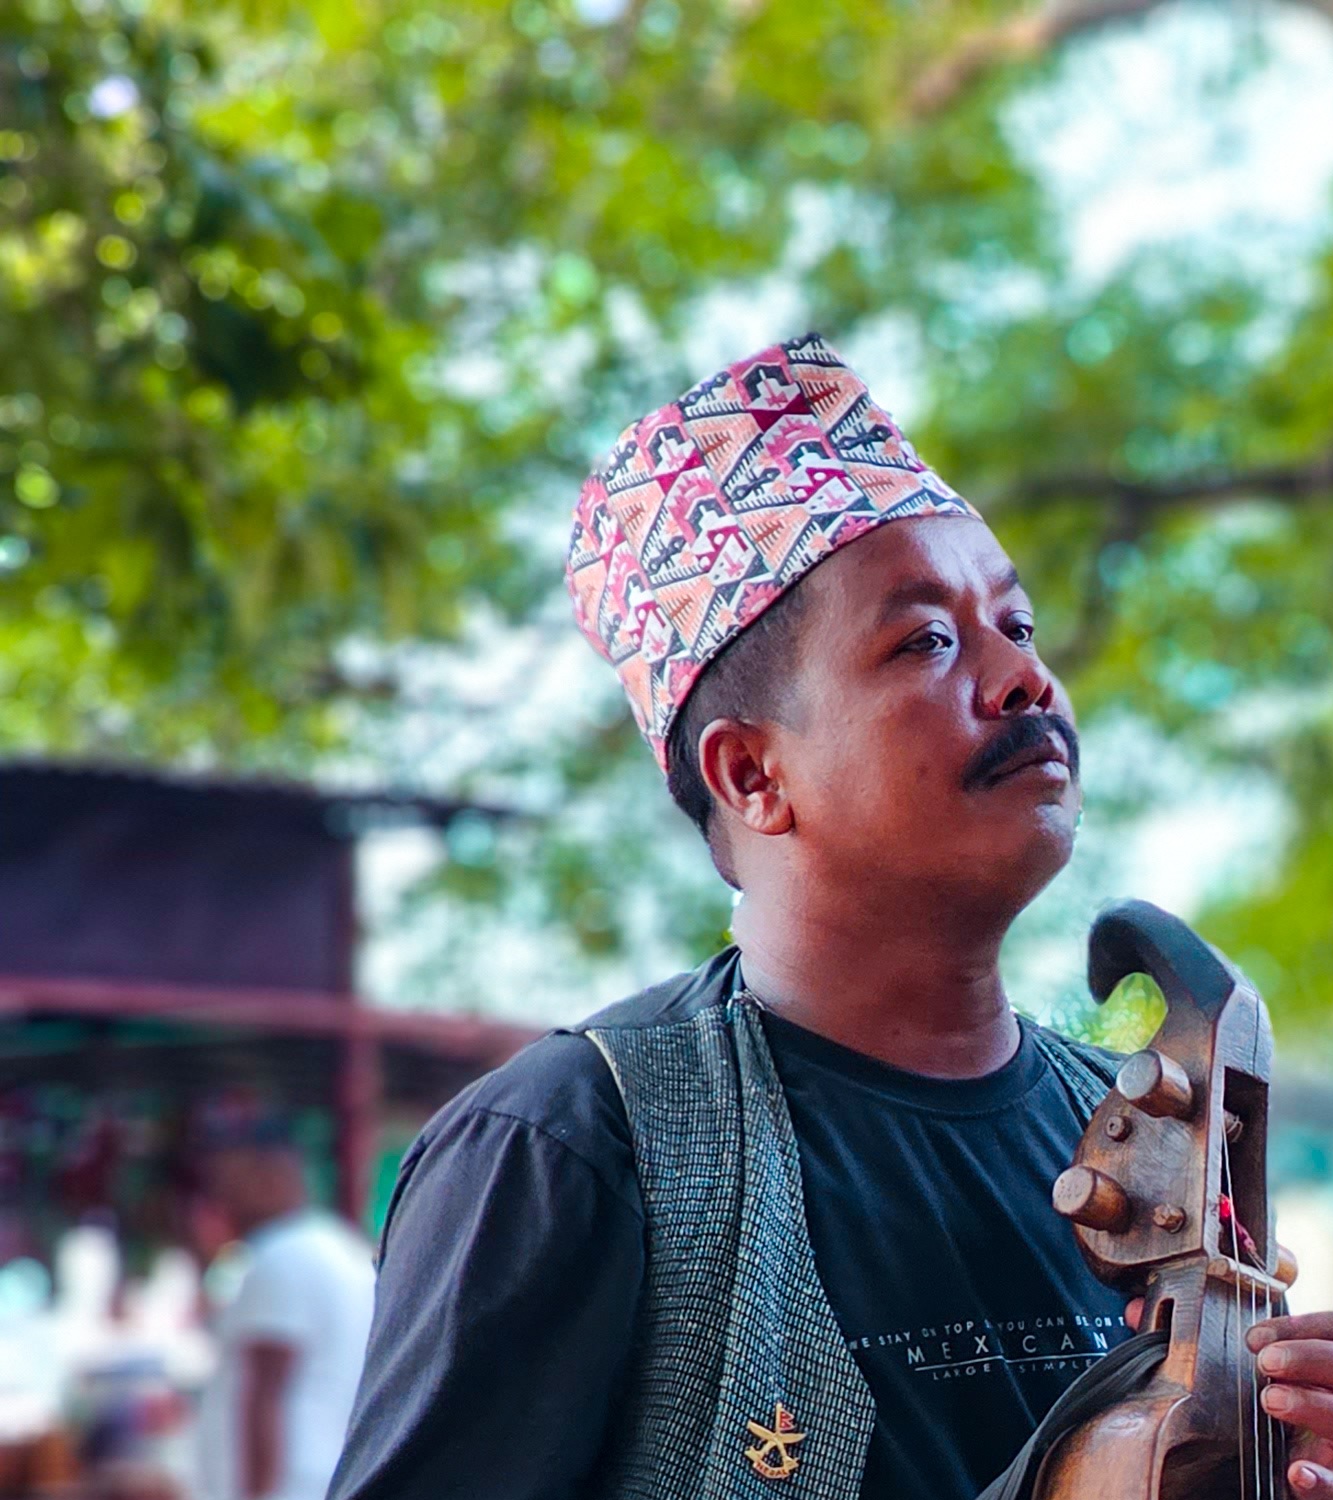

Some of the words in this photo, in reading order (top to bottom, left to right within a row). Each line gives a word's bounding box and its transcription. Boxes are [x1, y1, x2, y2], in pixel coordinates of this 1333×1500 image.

[879, 1331, 911, 1347] STAY
[944, 1320, 974, 1336] TOP
[997, 1320, 1025, 1331] YOU
[1035, 1316, 1065, 1329] CAN
[1094, 1317, 1112, 1328] ON
